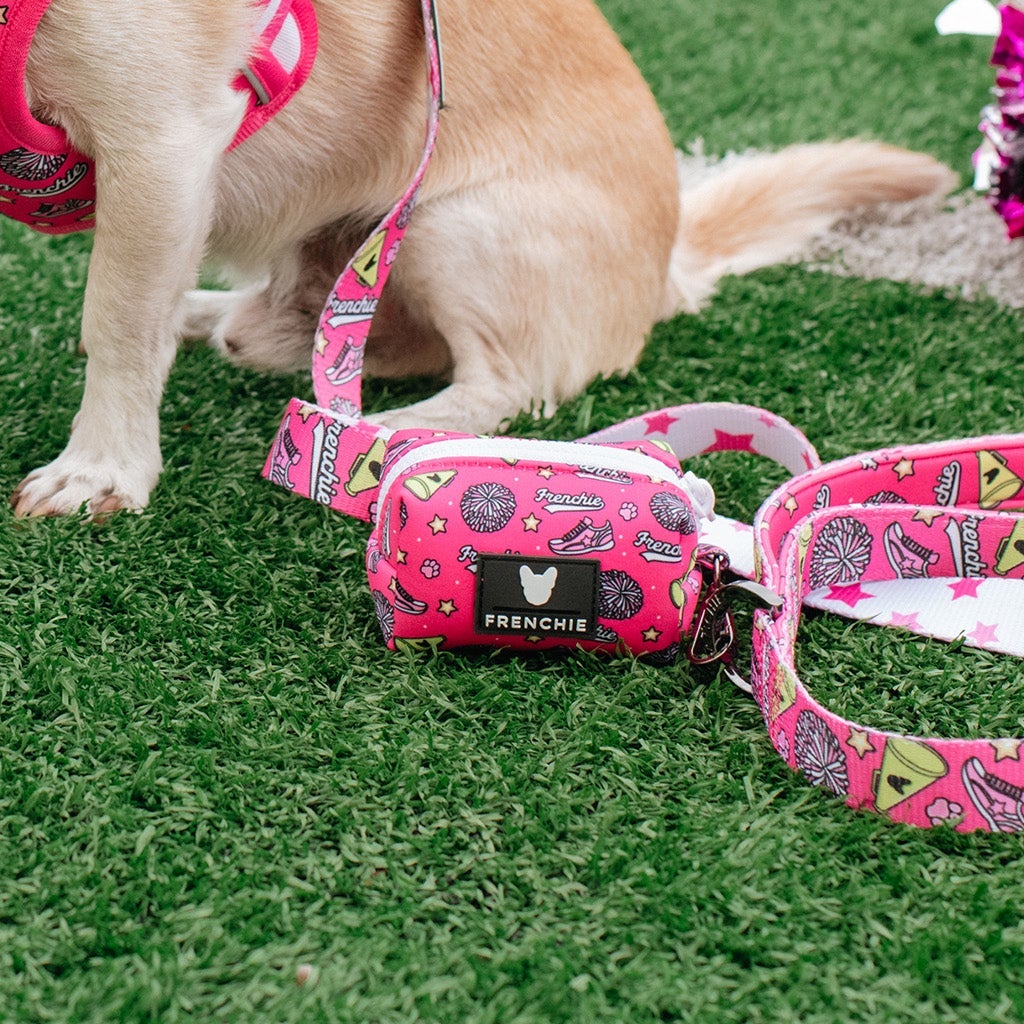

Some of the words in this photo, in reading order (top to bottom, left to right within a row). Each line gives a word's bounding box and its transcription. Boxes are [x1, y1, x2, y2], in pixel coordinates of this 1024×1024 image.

[316, 418, 348, 505] renchie
[535, 487, 605, 507] Frenchie
[634, 531, 681, 556] Frenc
[484, 614, 587, 632] FRENCHIE
